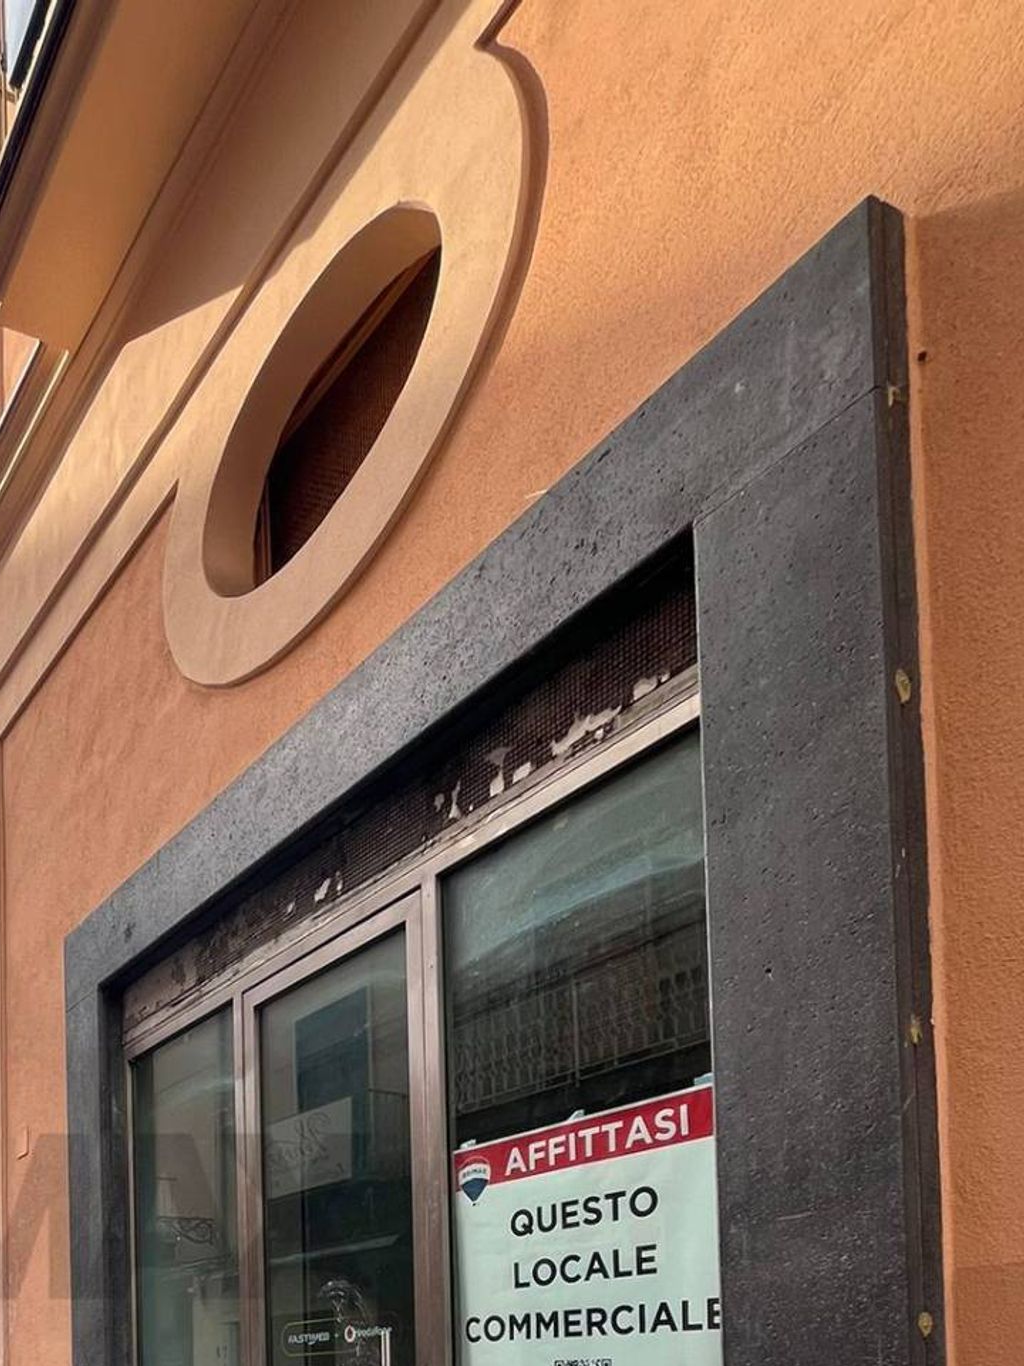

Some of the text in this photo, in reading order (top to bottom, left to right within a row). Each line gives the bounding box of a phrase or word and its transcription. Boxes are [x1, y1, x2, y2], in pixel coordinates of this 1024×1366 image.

[504, 1103, 690, 1176] AFFITTASI
[510, 1186, 659, 1237] QUESTO
[513, 1244, 658, 1289] LOCALE
[466, 1297, 721, 1343] COMMERCIALE
